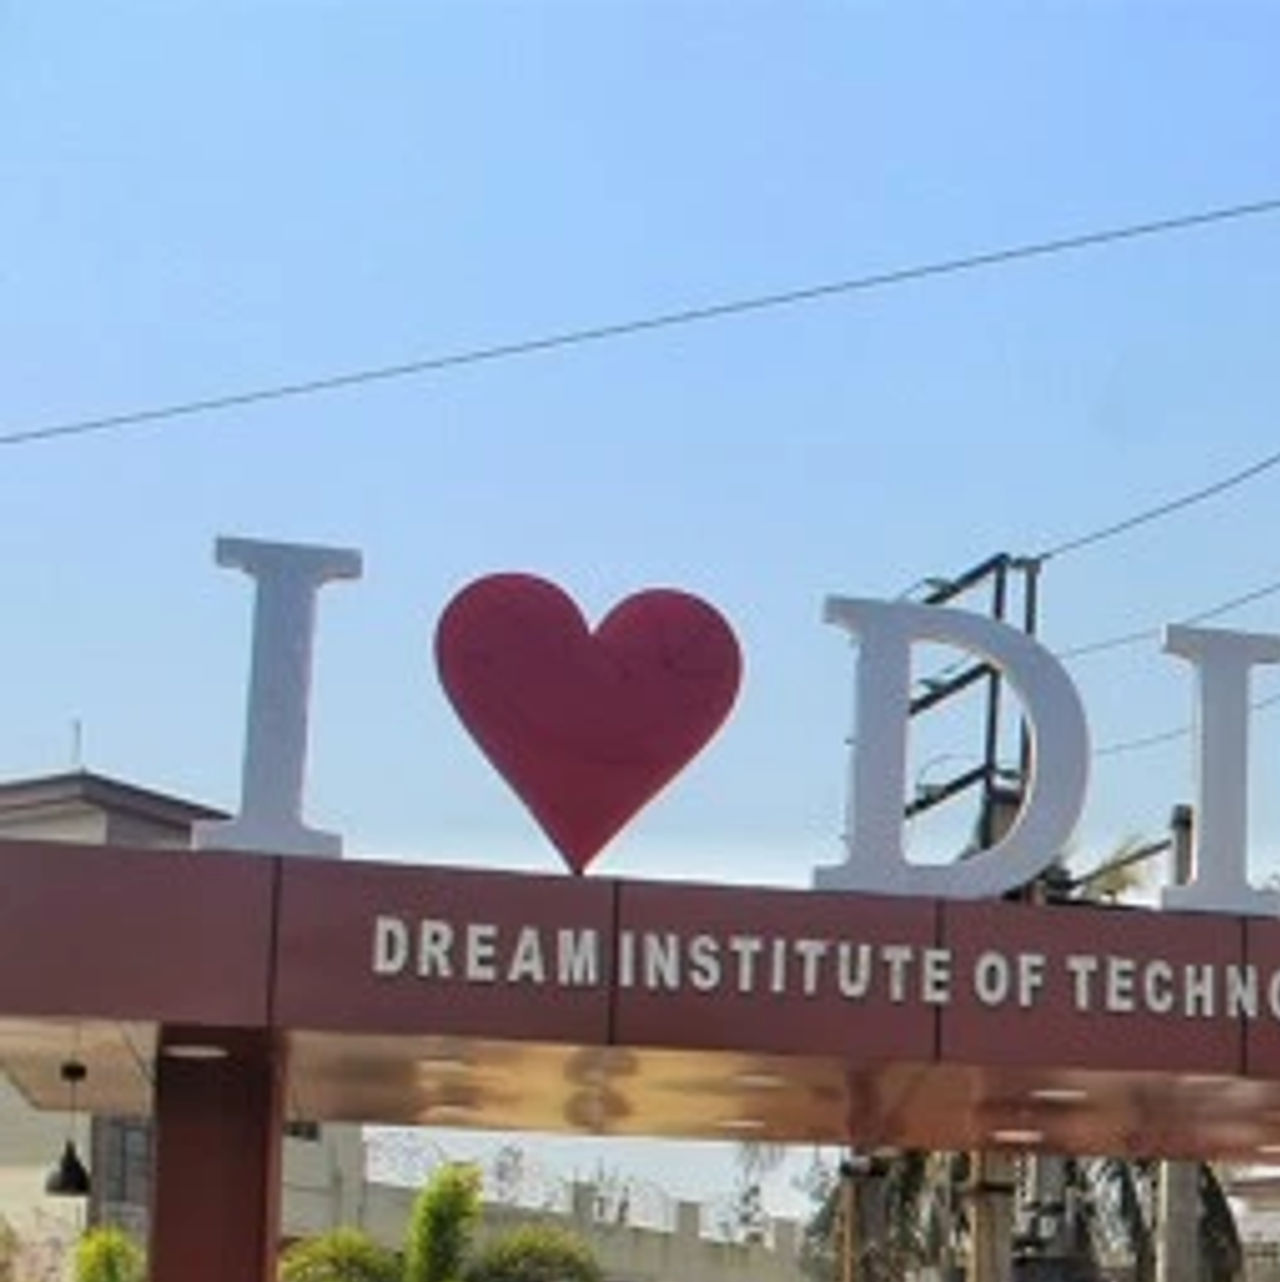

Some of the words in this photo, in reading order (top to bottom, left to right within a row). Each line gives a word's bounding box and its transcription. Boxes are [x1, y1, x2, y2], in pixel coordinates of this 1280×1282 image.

[192, 537, 363, 858] I
[372, 916, 598, 986] DREAM
[620, 935, 952, 1004] INSTITUTE
[975, 949, 1047, 1006] OF
